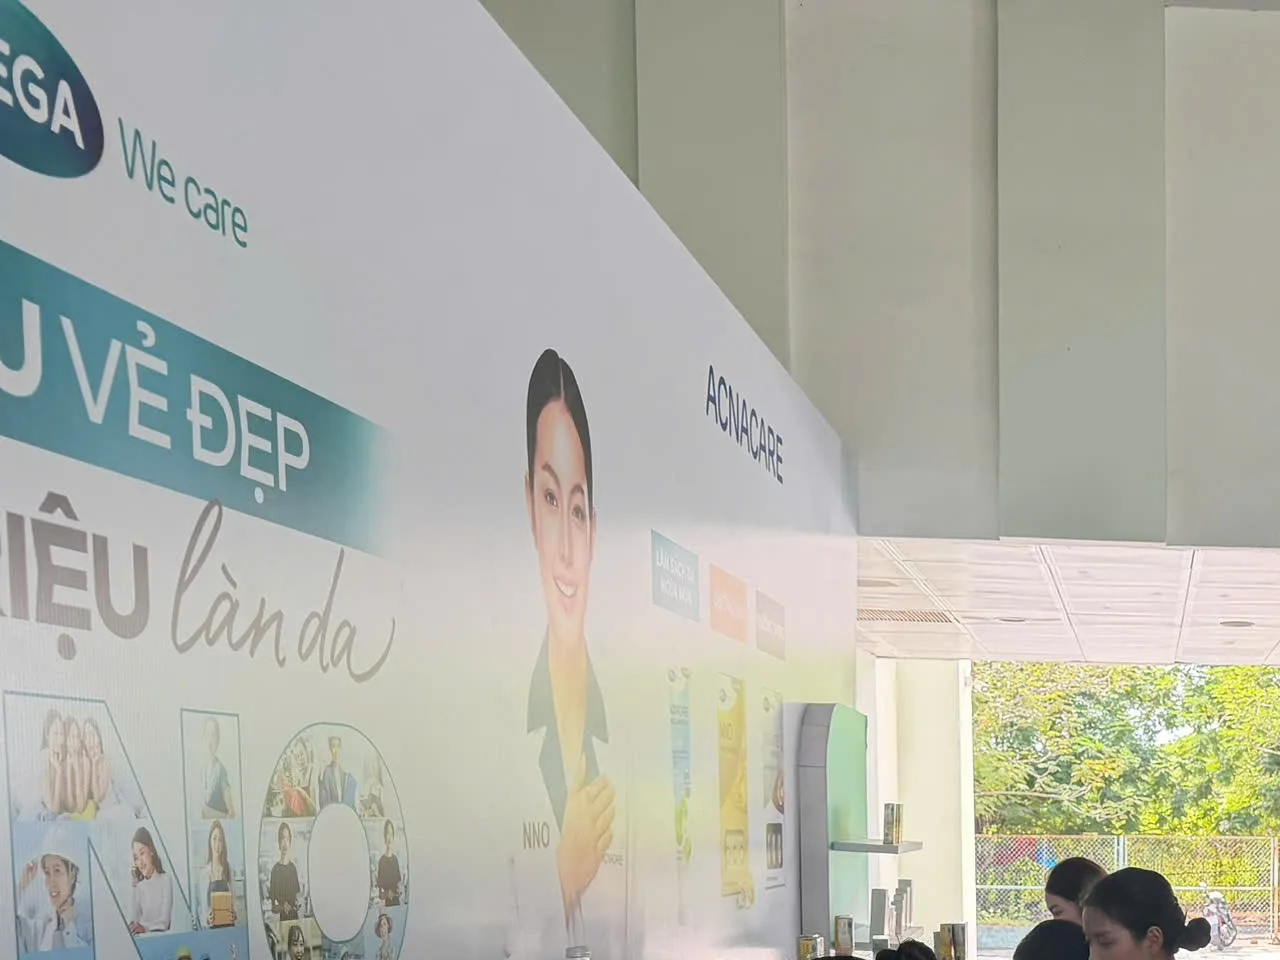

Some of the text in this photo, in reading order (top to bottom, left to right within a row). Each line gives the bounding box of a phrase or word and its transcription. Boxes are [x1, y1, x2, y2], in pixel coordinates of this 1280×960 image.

[117, 116, 248, 248] We care
[60, 315, 171, 449] VẺ
[186, 373, 310, 504] ĐẸP
[705, 365, 784, 485] ACNACARE
[0, 491, 396, 683] IỆU làn da
[523, 822, 550, 850] NNO
